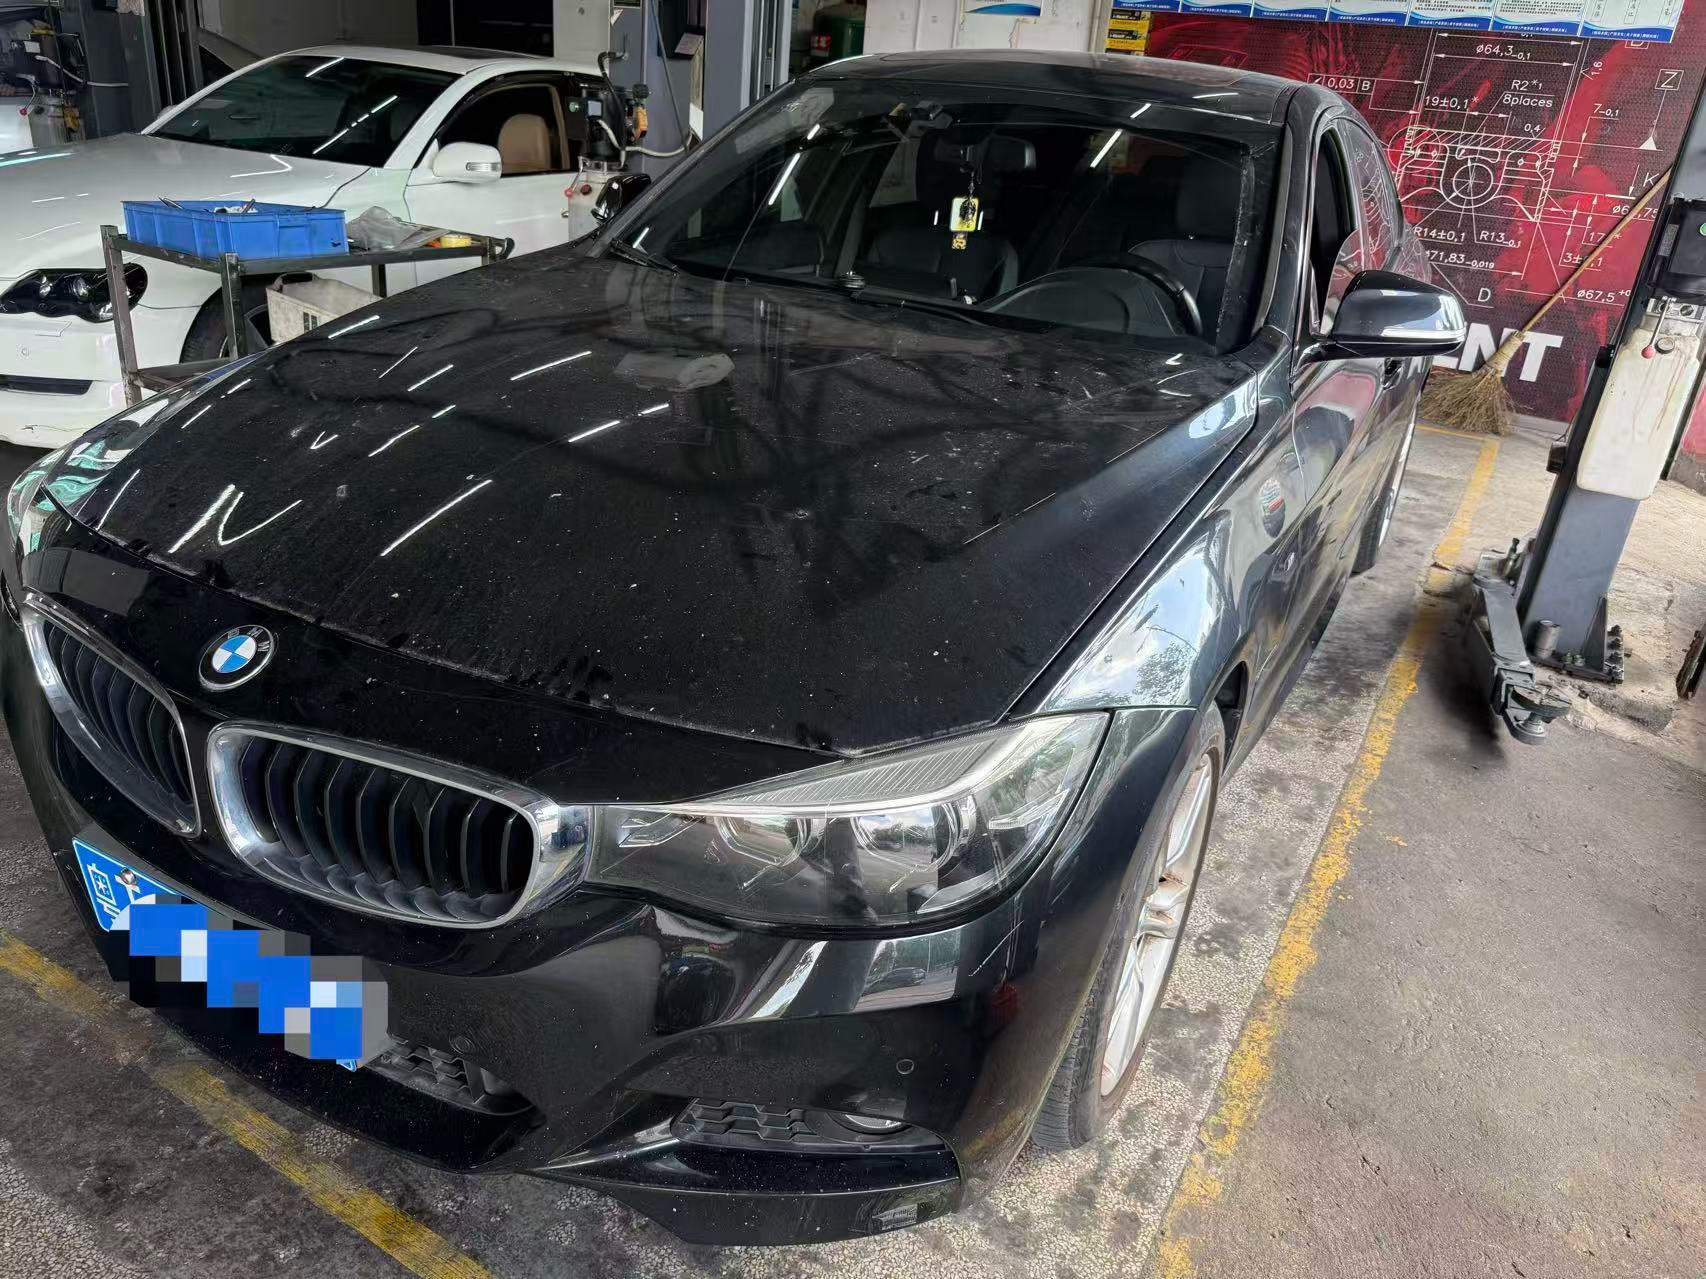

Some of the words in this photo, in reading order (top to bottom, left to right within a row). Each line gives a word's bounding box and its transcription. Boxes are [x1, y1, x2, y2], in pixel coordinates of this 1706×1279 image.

[1327, 78, 1354, 89] 0,03
[1361, 81, 1371, 91] B
[1661, 71, 1678, 88] Z
[1502, 93, 1553, 108] 8places
[1524, 123, 1541, 133] 0,4
[1643, 172, 1659, 187] K
[1563, 252, 1603, 267] 3±,1
[1477, 287, 1491, 302] D
[1432, 322, 1564, 382] NT
[227, 626, 270, 652] BMW
